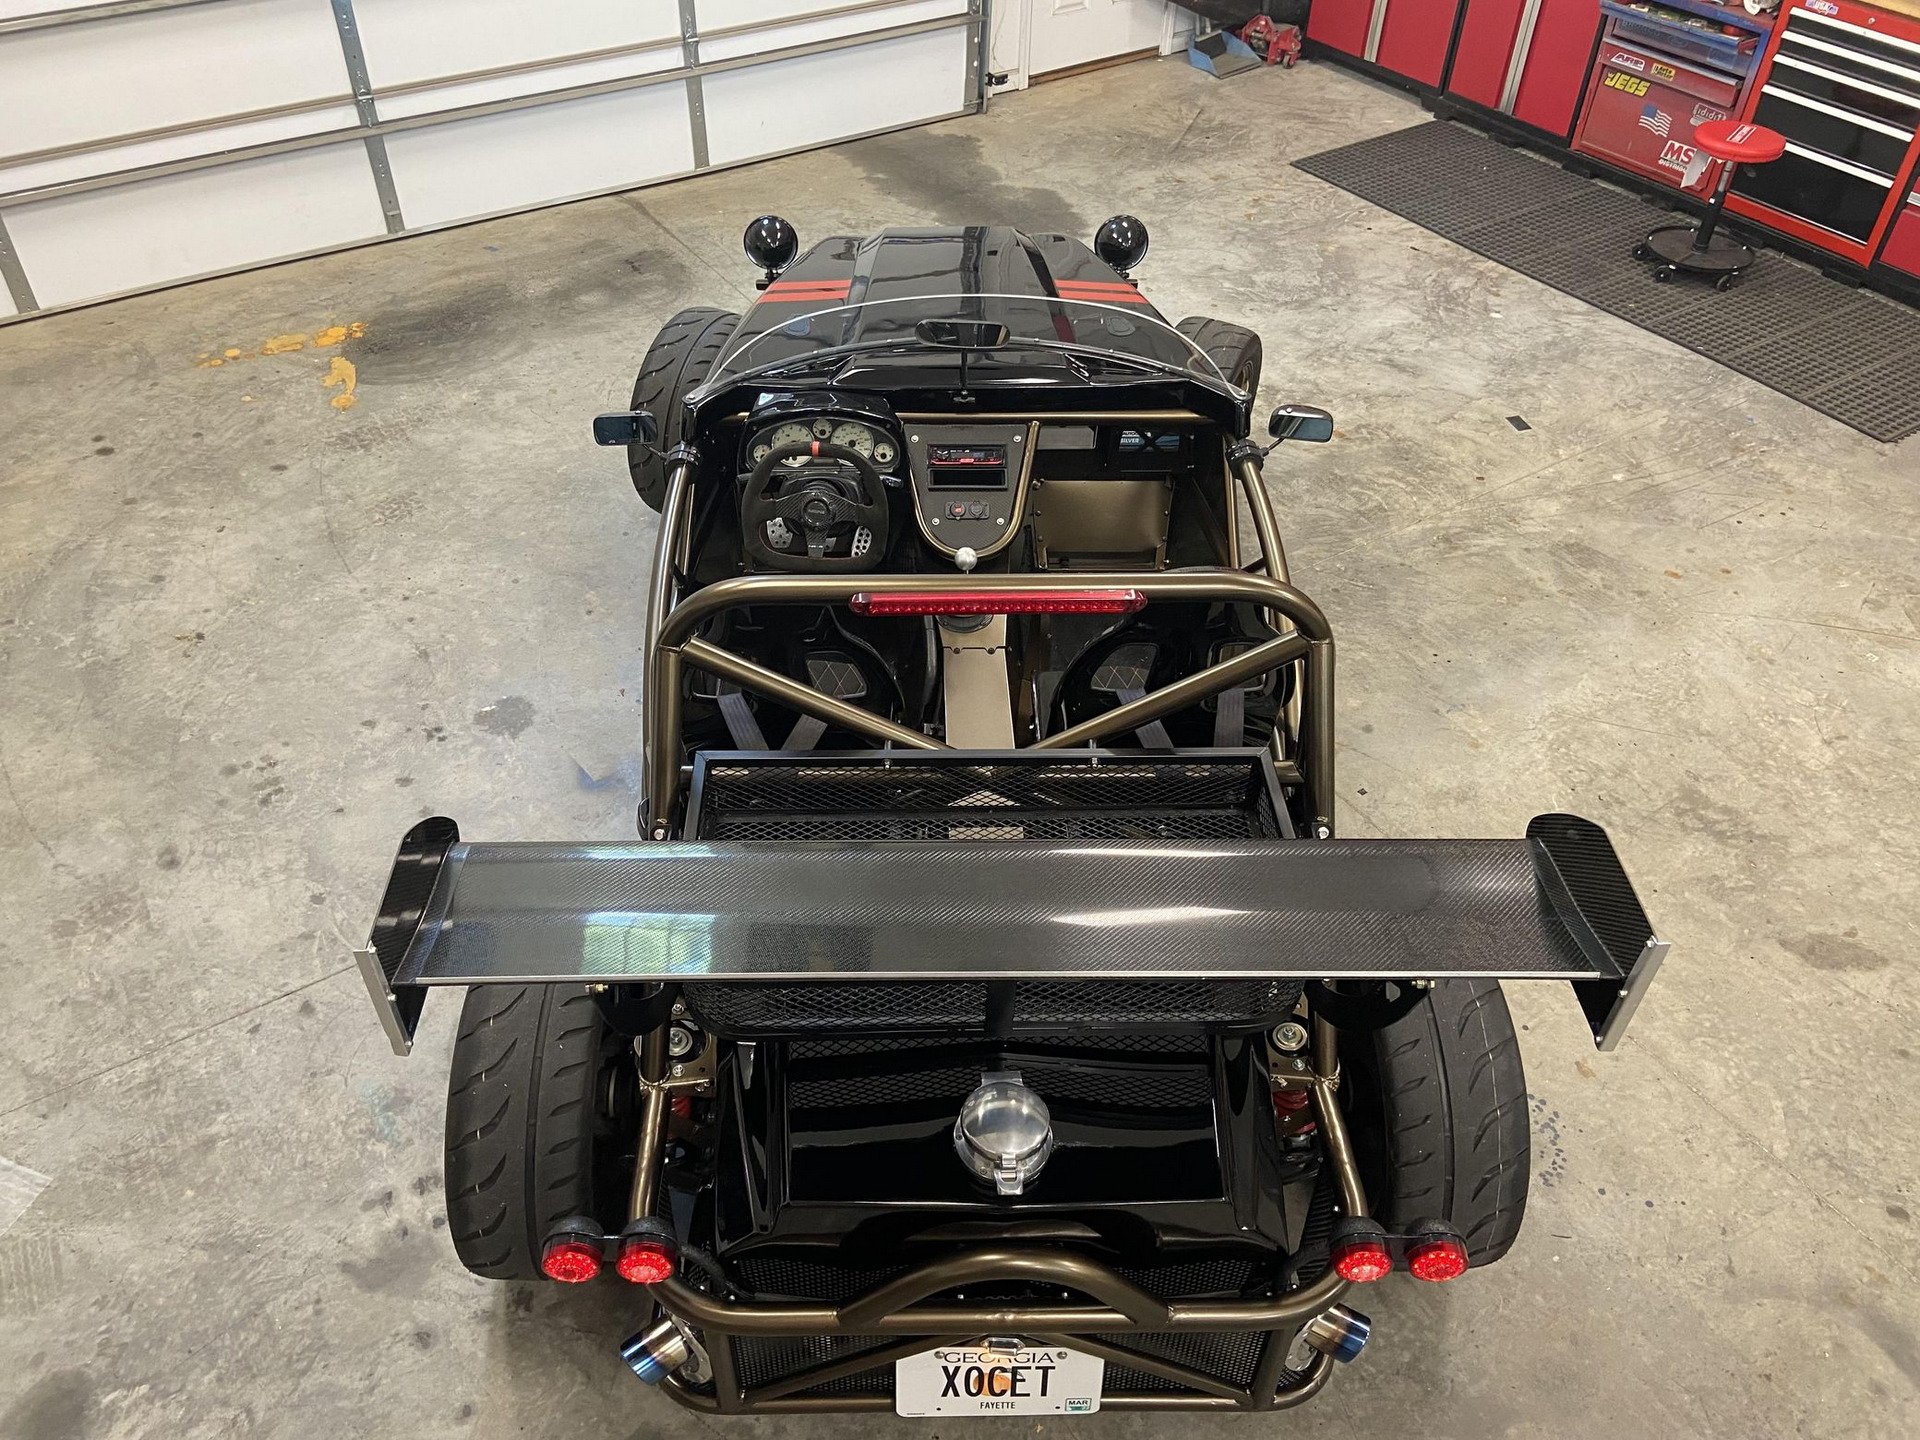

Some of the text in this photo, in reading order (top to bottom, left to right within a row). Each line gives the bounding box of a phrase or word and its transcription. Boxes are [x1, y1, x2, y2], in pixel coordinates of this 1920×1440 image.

[1614, 53, 1645, 68] ARP
[1604, 73, 1651, 96] JEGS
[1697, 107, 1723, 121] ididit
[1663, 141, 1697, 166] MS
[941, 1366, 1056, 1397] XOCET
[980, 1401, 1016, 1409] FAYETTE
